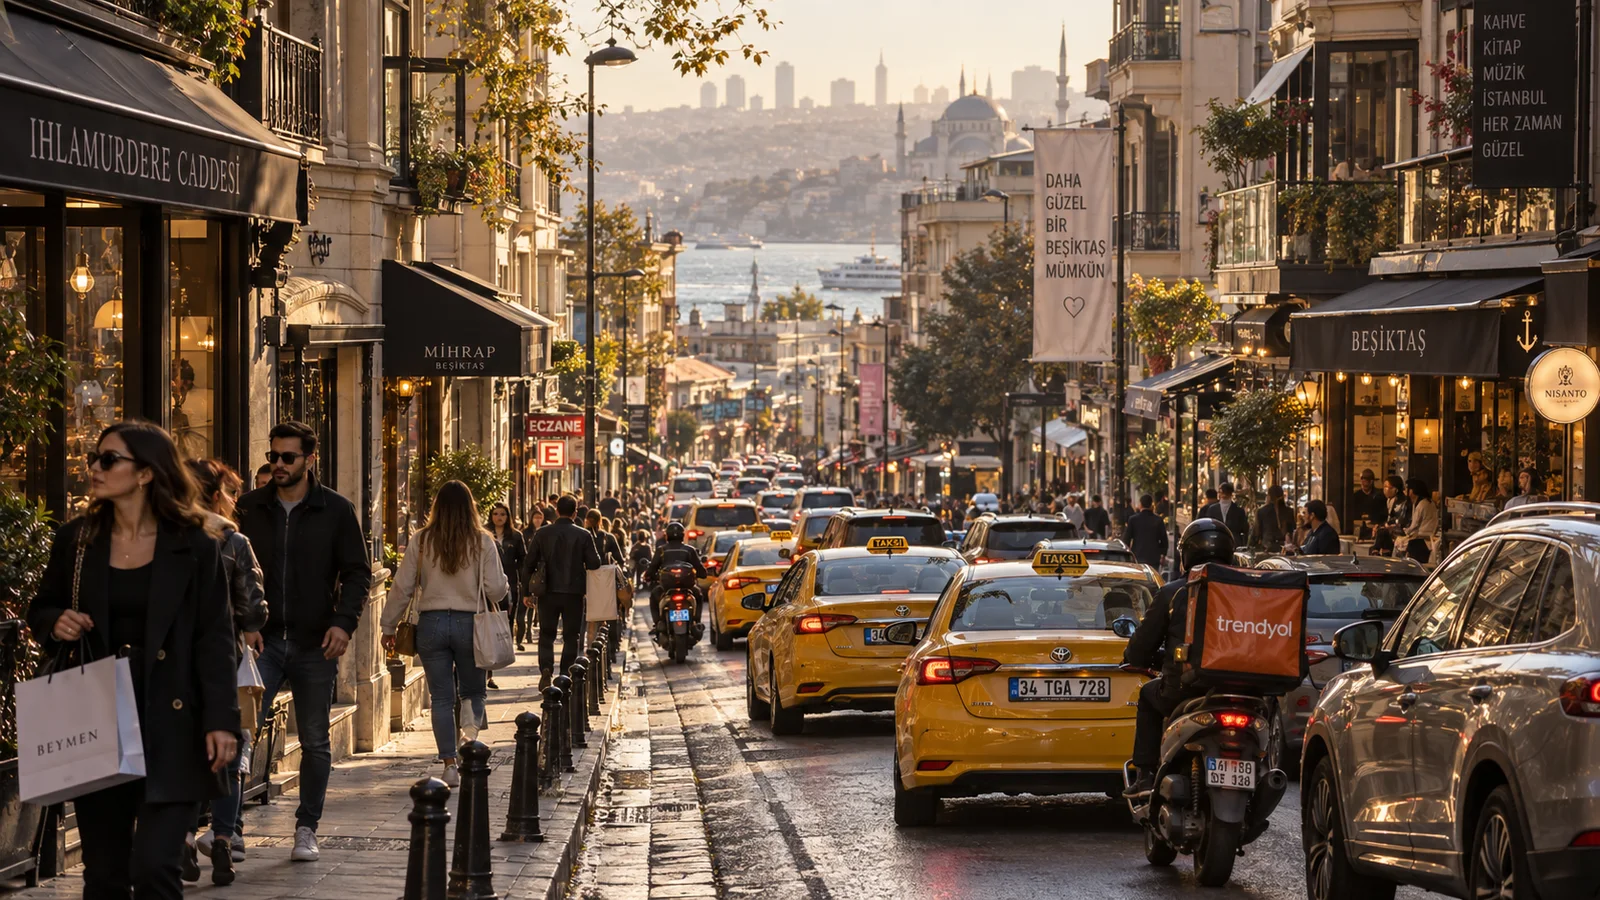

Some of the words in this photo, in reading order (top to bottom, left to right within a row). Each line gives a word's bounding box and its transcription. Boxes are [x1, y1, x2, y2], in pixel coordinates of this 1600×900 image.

[1483, 13, 1526, 30] KAHVE
[1483, 37, 1522, 56] KİTAP
[1483, 62, 1526, 82] MÜZİK
[1483, 88, 1547, 107] İSTANBUL
[1482, 116, 1509, 132] HER
[1514, 114, 1562, 131] ZAMAN
[30, 117, 172, 183] IHLAMURDERE
[177, 150, 241, 195] CADDESİ
[1482, 140, 1524, 158] GÜZEL
[1046, 173, 1082, 188] DAHA
[1045, 193, 1087, 210] GÜZEL
[1046, 214, 1067, 233] BİR
[1046, 238, 1106, 258] BEŞİKTAŞ
[1045, 261, 1105, 279] MÜMKÜN
[424, 342, 496, 358] MİHRAP
[1351, 325, 1427, 358] BEŞİKTAŞ
[1545, 389, 1588, 399] NISANTO
[529, 420, 582, 433] ECZANE
[544, 445, 559, 464] E
[1043, 554, 1079, 564] TAKSI
[1216, 615, 1292, 640] trendyol
[1020, 680, 1038, 696] 34
[1044, 680, 1072, 696] TGA
[1078, 680, 1106, 696] 728
[37, 729, 98, 757] BEYMEN
